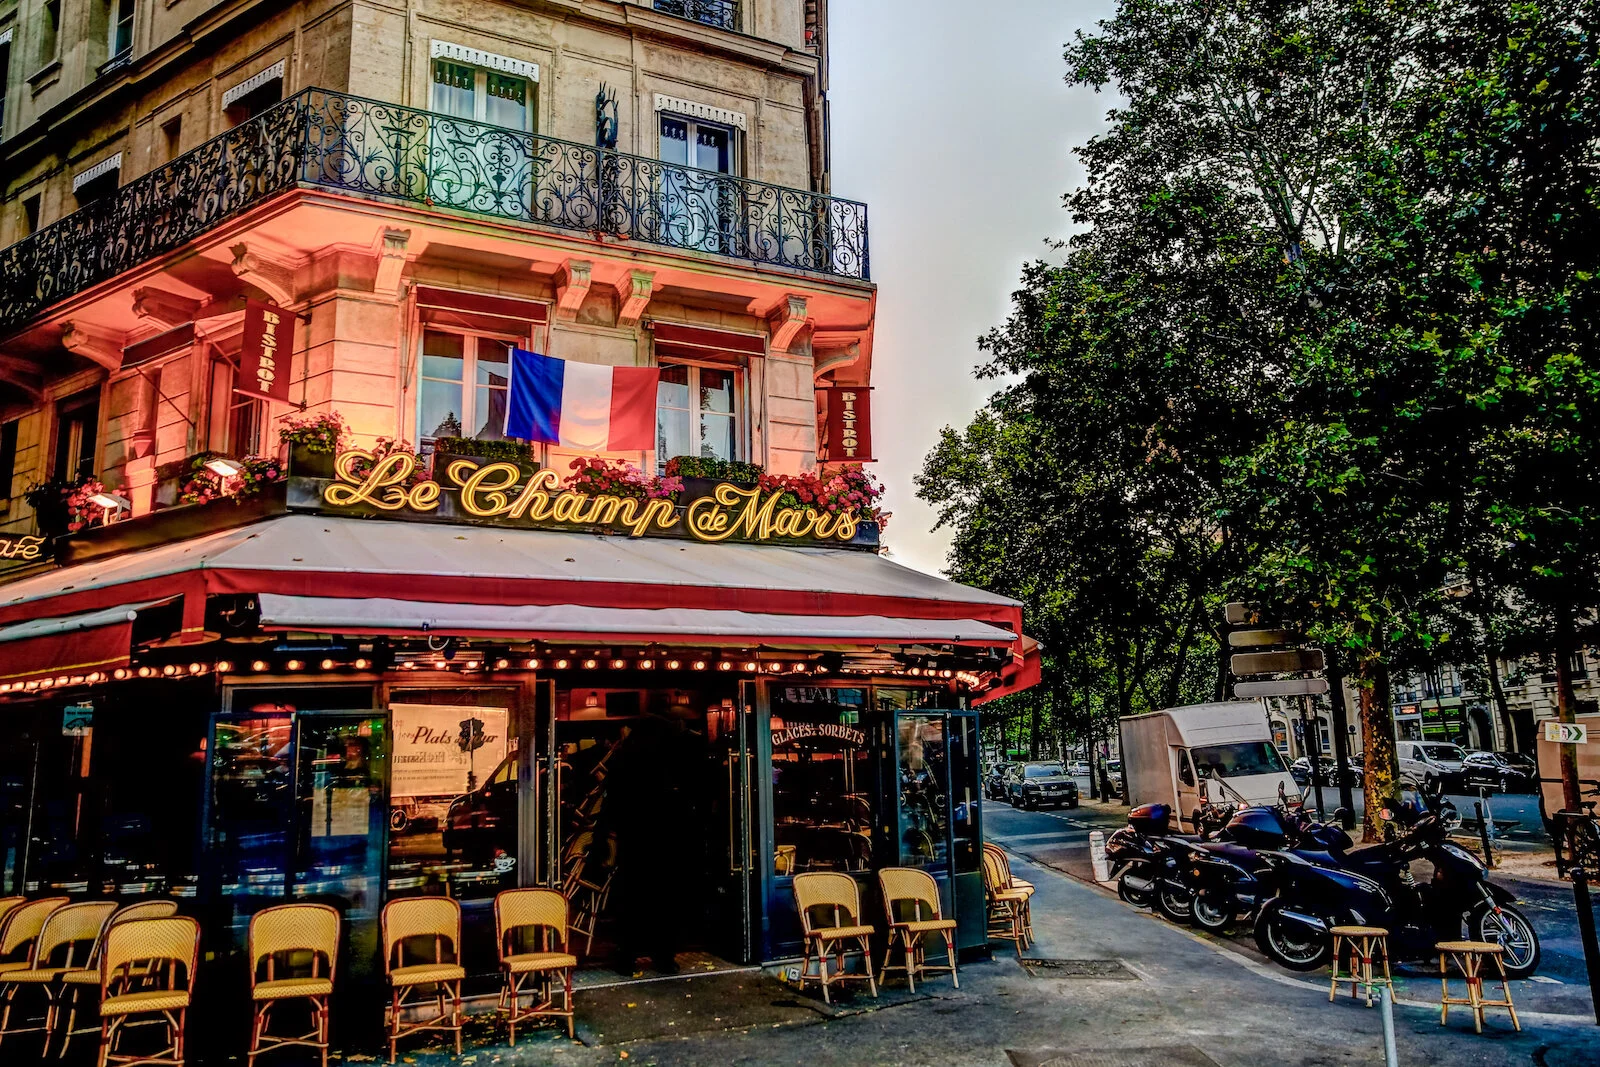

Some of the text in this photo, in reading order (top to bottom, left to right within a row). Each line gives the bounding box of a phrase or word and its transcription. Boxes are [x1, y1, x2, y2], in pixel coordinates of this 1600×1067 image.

[256, 310, 280, 393] BISTROT
[841, 391, 858, 457] BISTROT
[323, 449, 862, 541] Le Champ de Mars
[0, 535, 47, 560] afé
[411, 726, 451, 745] Plats
[771, 724, 811, 745] GLACES
[818, 723, 865, 744] SORBETS
